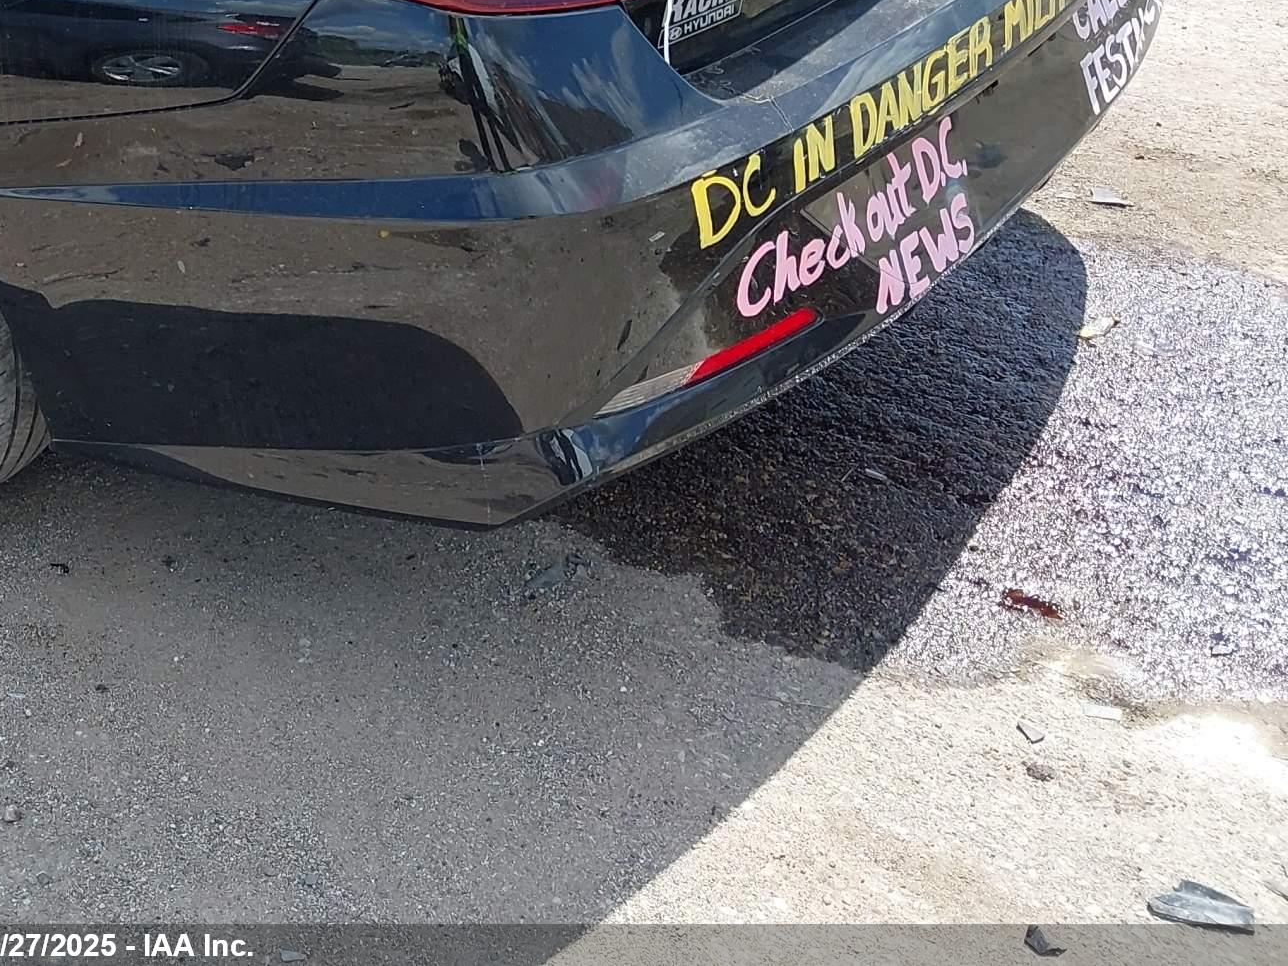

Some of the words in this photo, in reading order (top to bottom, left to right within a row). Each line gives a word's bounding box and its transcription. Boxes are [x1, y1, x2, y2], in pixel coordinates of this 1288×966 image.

[684, 4, 735, 34] HYUNDAI
[691, 154, 776, 249] DC
[793, 116, 836, 193] IN
[849, 16, 993, 160] DANGER
[737, 192, 865, 317] Check
[866, 153, 916, 241] out
[876, 192, 975, 314] NEWS
